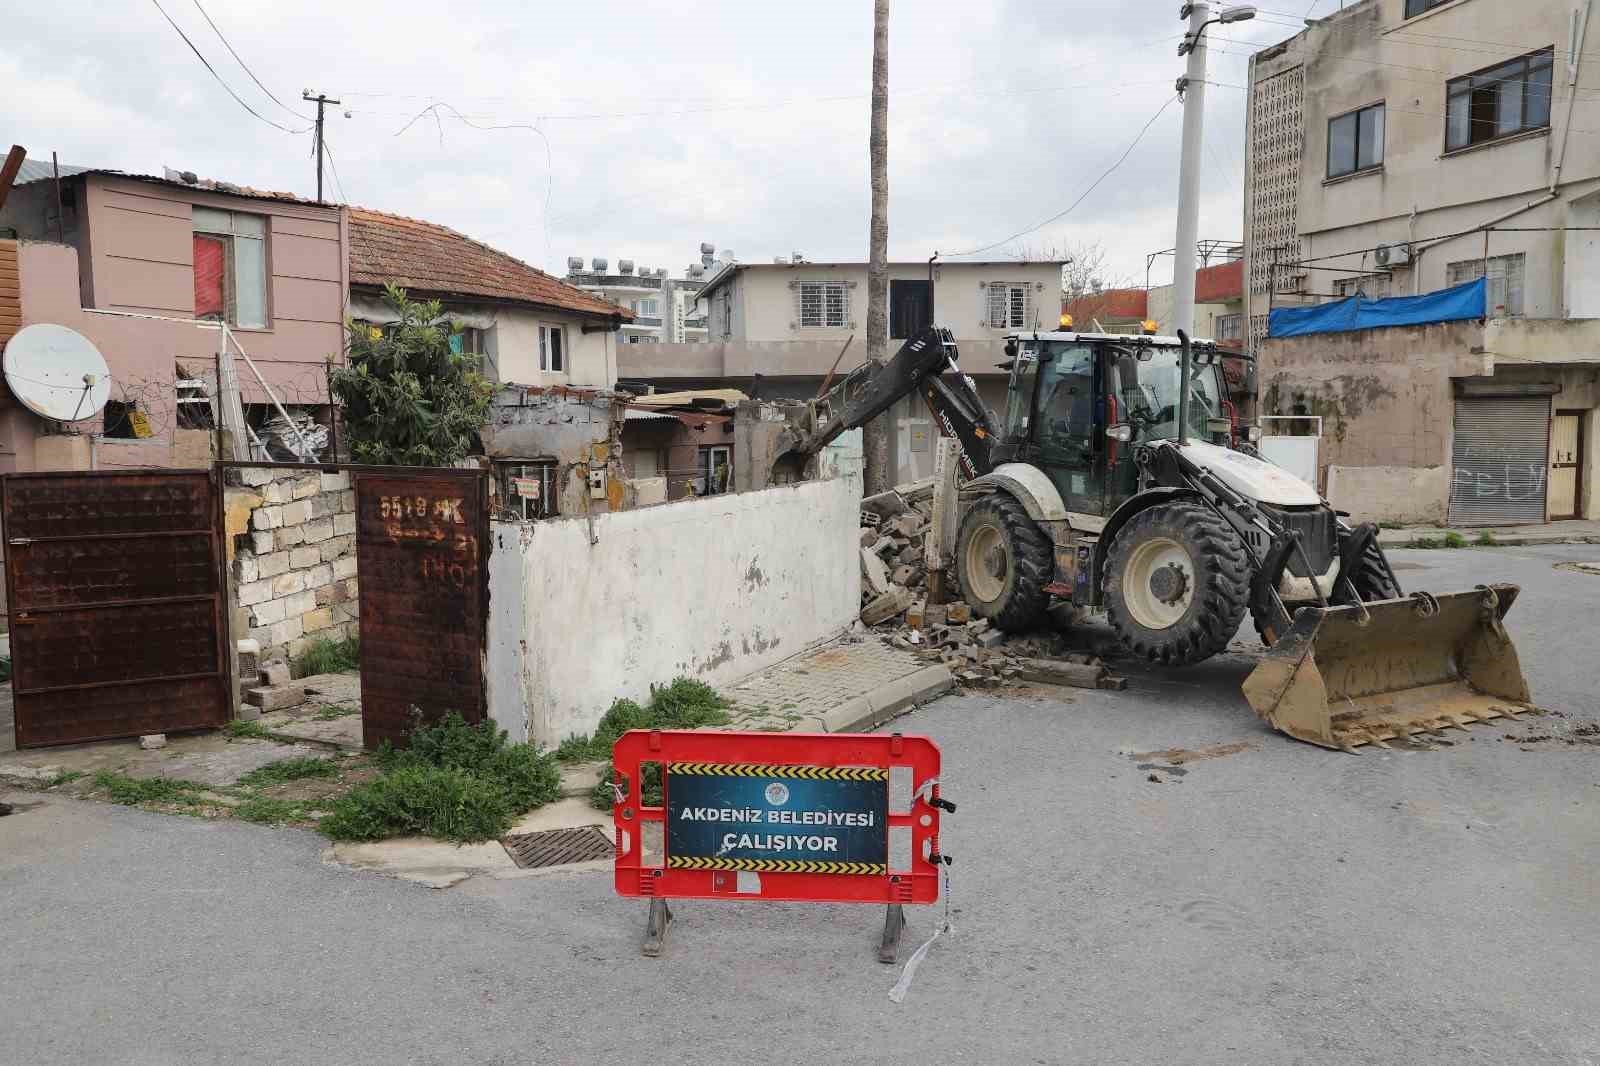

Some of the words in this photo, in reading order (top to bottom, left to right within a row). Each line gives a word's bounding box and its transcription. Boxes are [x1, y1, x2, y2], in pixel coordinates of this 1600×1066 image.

[939, 409, 978, 476] HIDRMEK
[680, 807, 763, 823] AKDENİZ
[767, 809, 875, 827] BELEDİYESİ
[723, 833, 838, 852] ÇALIŞIYOR
